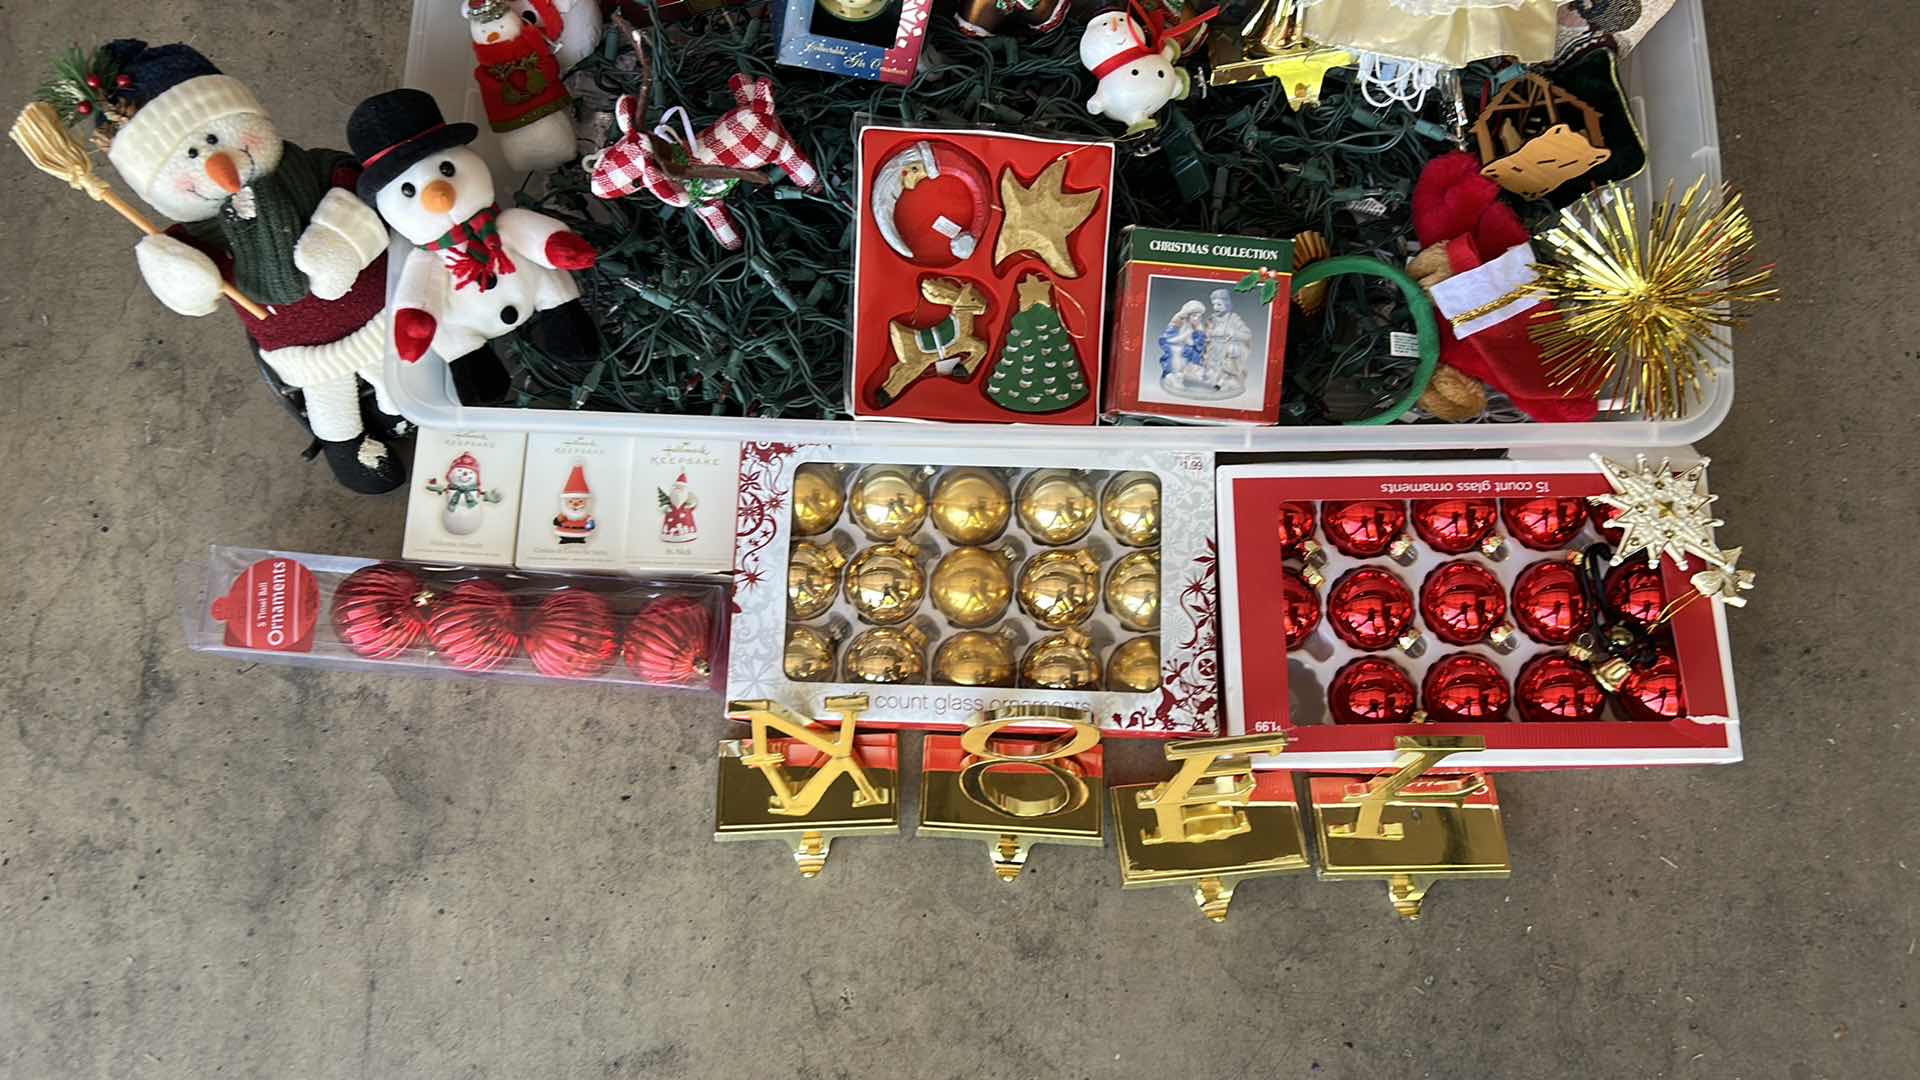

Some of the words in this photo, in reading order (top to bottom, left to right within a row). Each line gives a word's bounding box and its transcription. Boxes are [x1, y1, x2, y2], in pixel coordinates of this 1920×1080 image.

[1149, 239, 1209, 255] CHRISTMAS
[1212, 245, 1279, 260] COLLECTION
[650, 456, 721, 466] KEEPSAKE
[1380, 481, 1454, 494] ornaments
[1456, 480, 1491, 493] glass
[1495, 481, 1533, 493] count
[1535, 481, 1551, 493] 15
[257, 582, 268, 597] Ball
[267, 561, 286, 646] Ornaments
[875, 693, 929, 709] count
[935, 692, 984, 715] glass
